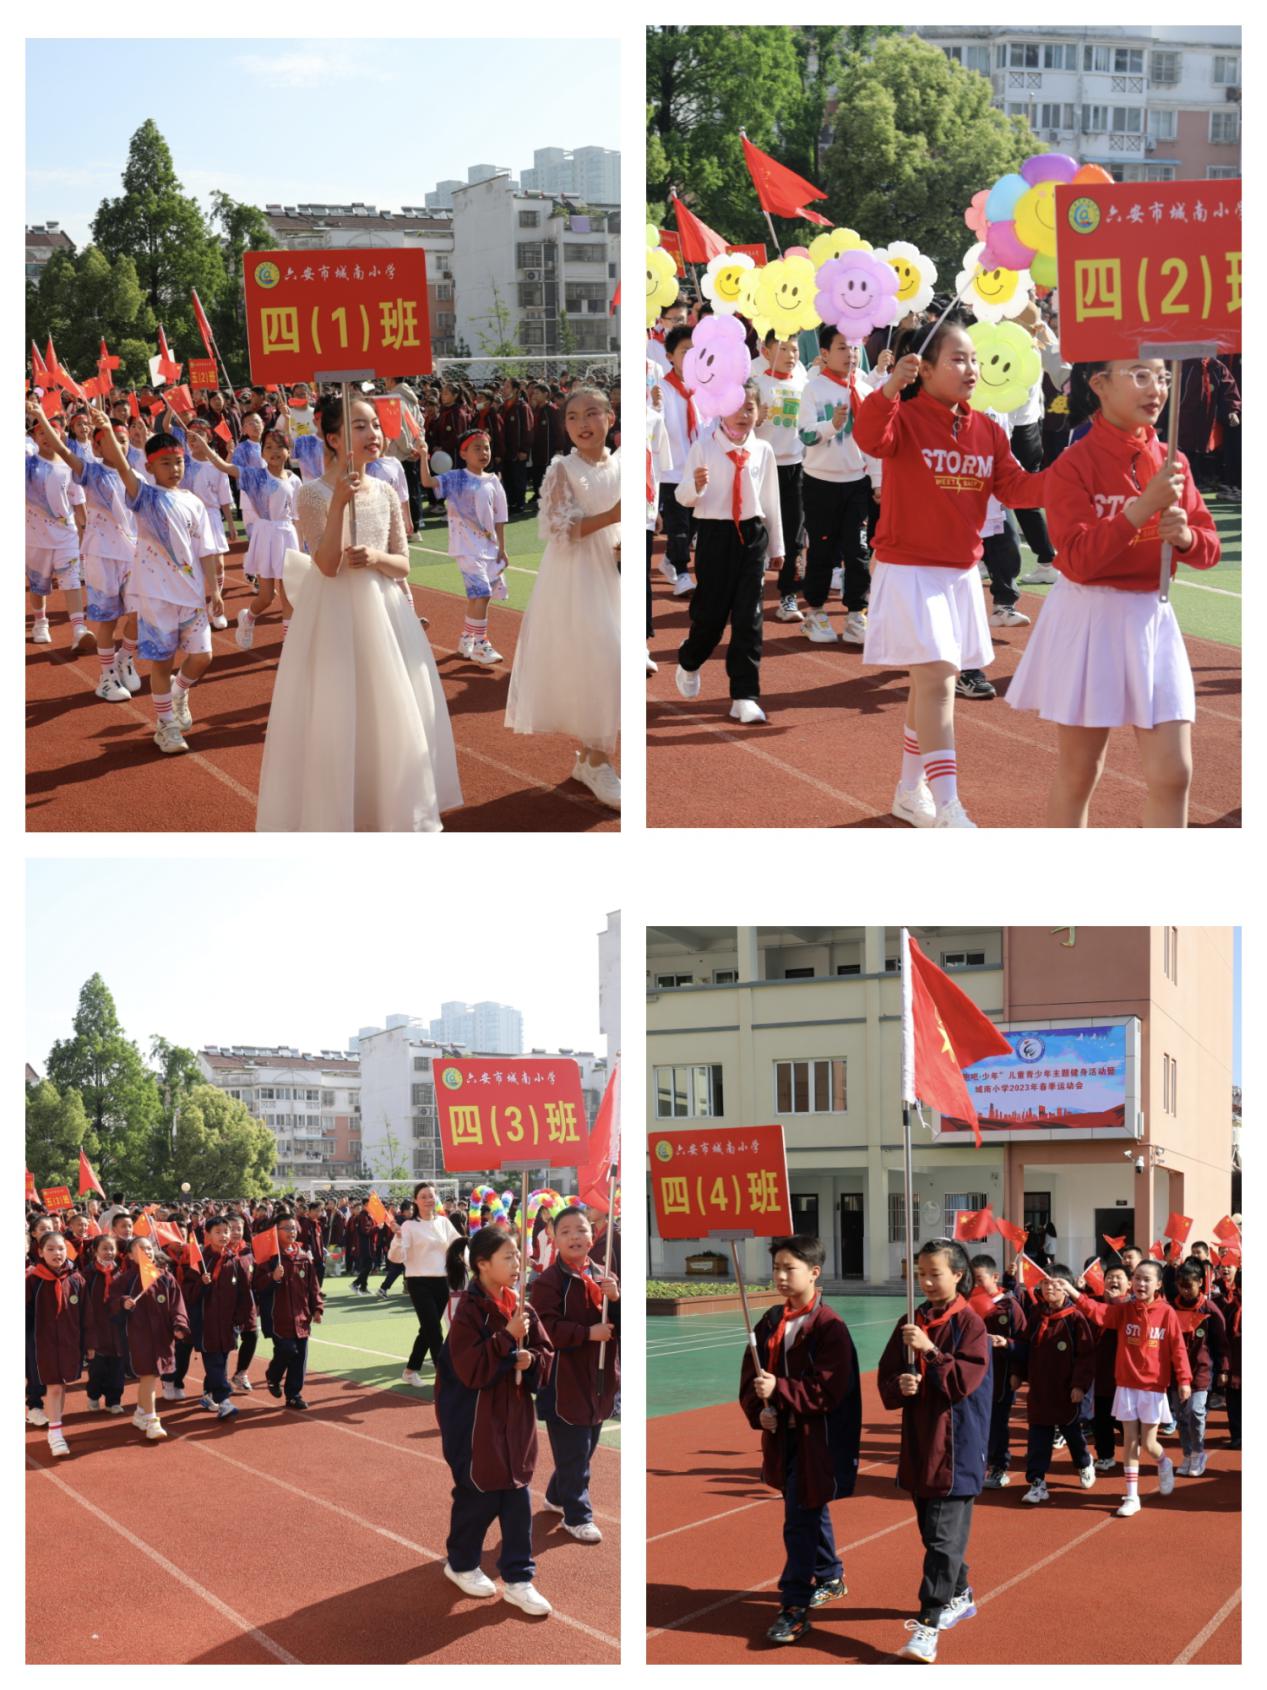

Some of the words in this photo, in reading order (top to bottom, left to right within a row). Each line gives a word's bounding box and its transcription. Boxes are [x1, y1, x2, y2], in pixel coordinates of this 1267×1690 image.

[284, 263, 396, 281] 六安市城南小学
[260, 298, 420, 355] 四(1)班
[921, 448, 994, 478] STORM
[466, 1071, 557, 1085] 六安市城南小学
[975, 1081, 1084, 1093] 城南小学2023年春季运动会
[449, 1100, 580, 1146] 四(3)班
[675, 1138, 760, 1156] 六安市城南小学
[661, 1169, 781, 1216] 四(4)班
